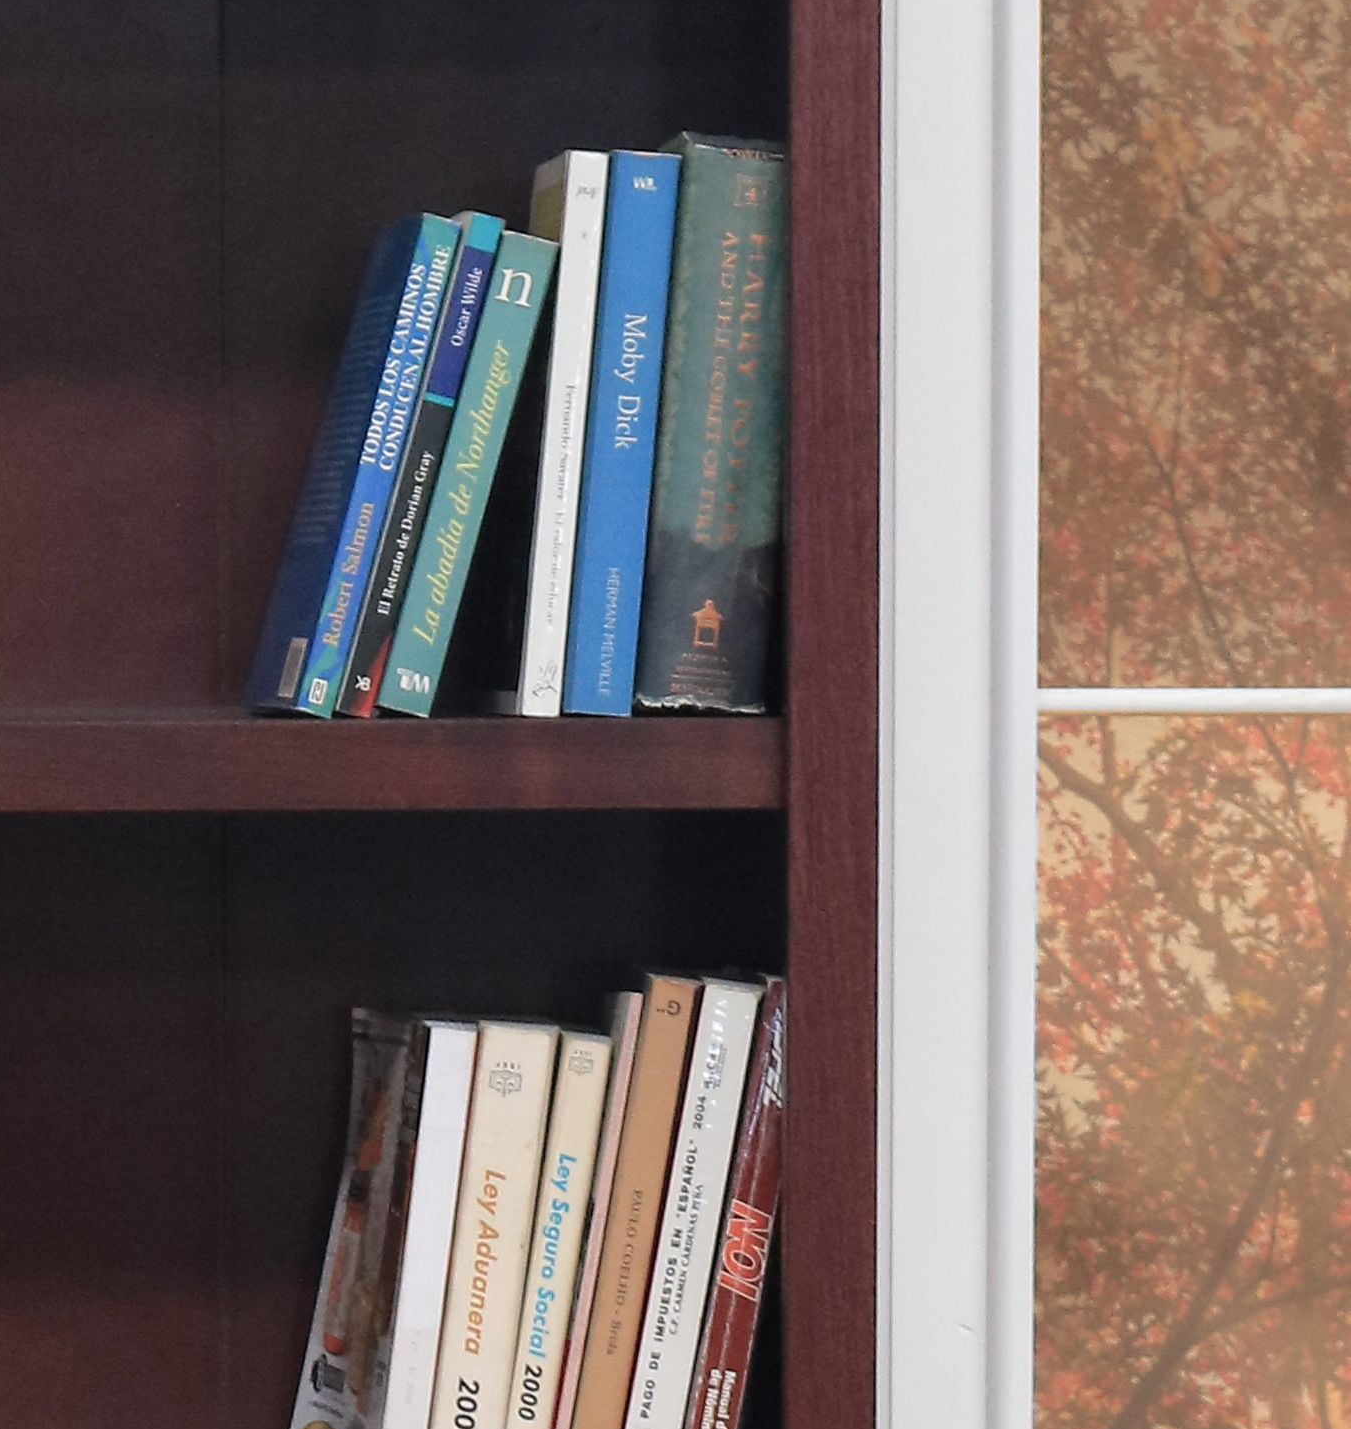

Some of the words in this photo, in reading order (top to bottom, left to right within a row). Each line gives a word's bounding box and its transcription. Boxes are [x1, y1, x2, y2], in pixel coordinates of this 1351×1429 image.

[416, 243, 451, 331] HOMBRE
[460, 266, 483, 305] Wilde
[495, 267, 534, 309] n
[721, 232, 738, 290] AND
[408, 332, 429, 361] AL
[450, 308, 473, 347] Oscar
[615, 314, 647, 384] Moby
[360, 399, 389, 466] TODOS
[379, 358, 401, 398] LOS
[390, 262, 426, 355] CAMINOS
[379, 362, 420, 471] CONDUCEN
[456, 338, 511, 484] Northanger
[614, 395, 641, 450] Dick
[413, 450, 435, 483] Gray
[400, 486, 423, 529] Dorian
[449, 484, 473, 516] de
[395, 533, 410, 548] de
[427, 518, 464, 605] abadía
[323, 582, 354, 647] Robert
[342, 503, 375, 575] Salmon
[382, 550, 405, 598] Retrato
[604, 567, 619, 628] HERMAN
[377, 600, 391, 616] El
[412, 609, 440, 646] La
[599, 630, 616, 695] MELVILLE
[477, 1168, 506, 1216] Ley
[551, 1153, 577, 1192] Ley
[542, 1199, 570, 1279] Seguro
[640, 1379, 656, 1419] PAGO
[649, 1352, 661, 1372] DE
[655, 1257, 678, 1342] IMPUESTOS
[671, 1229, 683, 1249] EN
[693, 1095, 707, 1130] 2004
[719, 1199, 771, 1302] NOI
[464, 1221, 499, 1356] Aduanera
[616, 1244, 634, 1307] COELHO
[675, 1269, 688, 1312] CARMEN
[529, 1287, 555, 1359] Social
[519, 1363, 543, 1420] 2000
[709, 1369, 721, 1384] de
[718, 1370, 736, 1418] Manual
